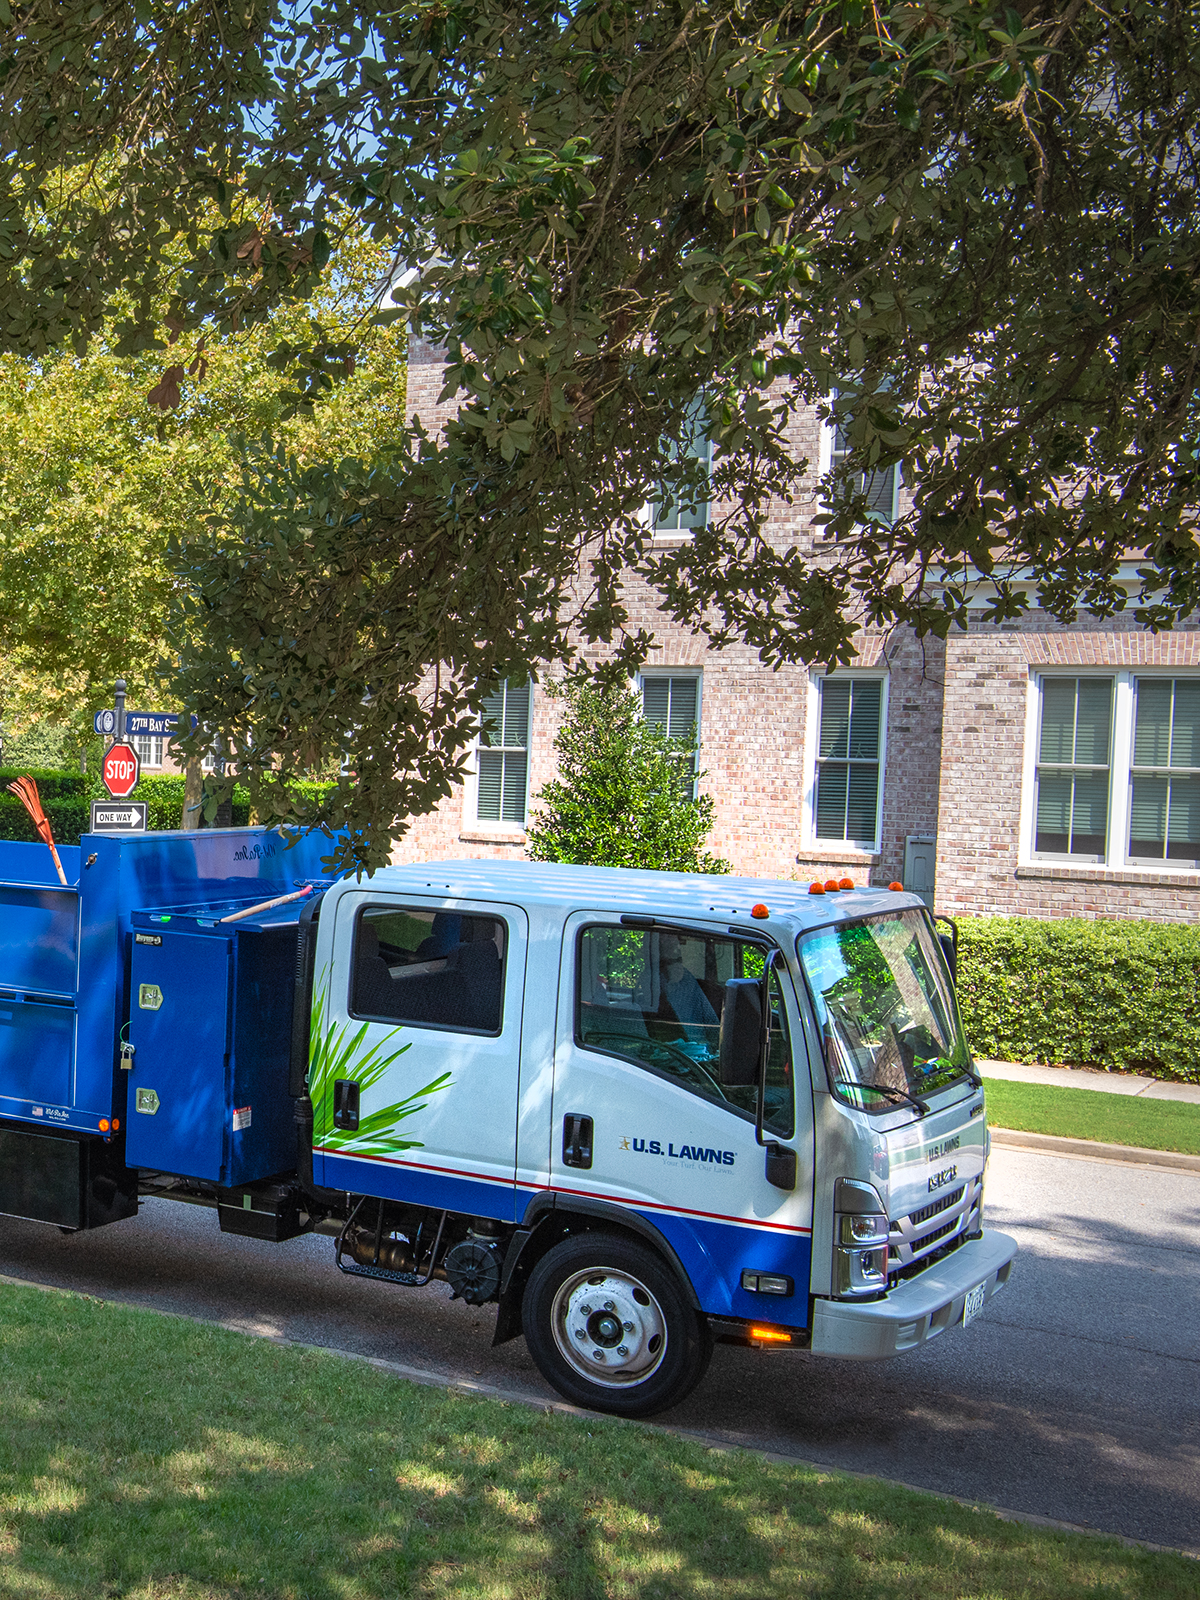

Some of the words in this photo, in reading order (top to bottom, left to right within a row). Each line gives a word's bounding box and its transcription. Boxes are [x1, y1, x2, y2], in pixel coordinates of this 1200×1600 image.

[106, 760, 135, 780] STOP
[99, 813, 115, 822] ONE
[116, 813, 132, 822] WAY
[632, 1138, 665, 1156] U.S.
[668, 1143, 735, 1165] LAWNS
[940, 1135, 960, 1157] LAWNS
